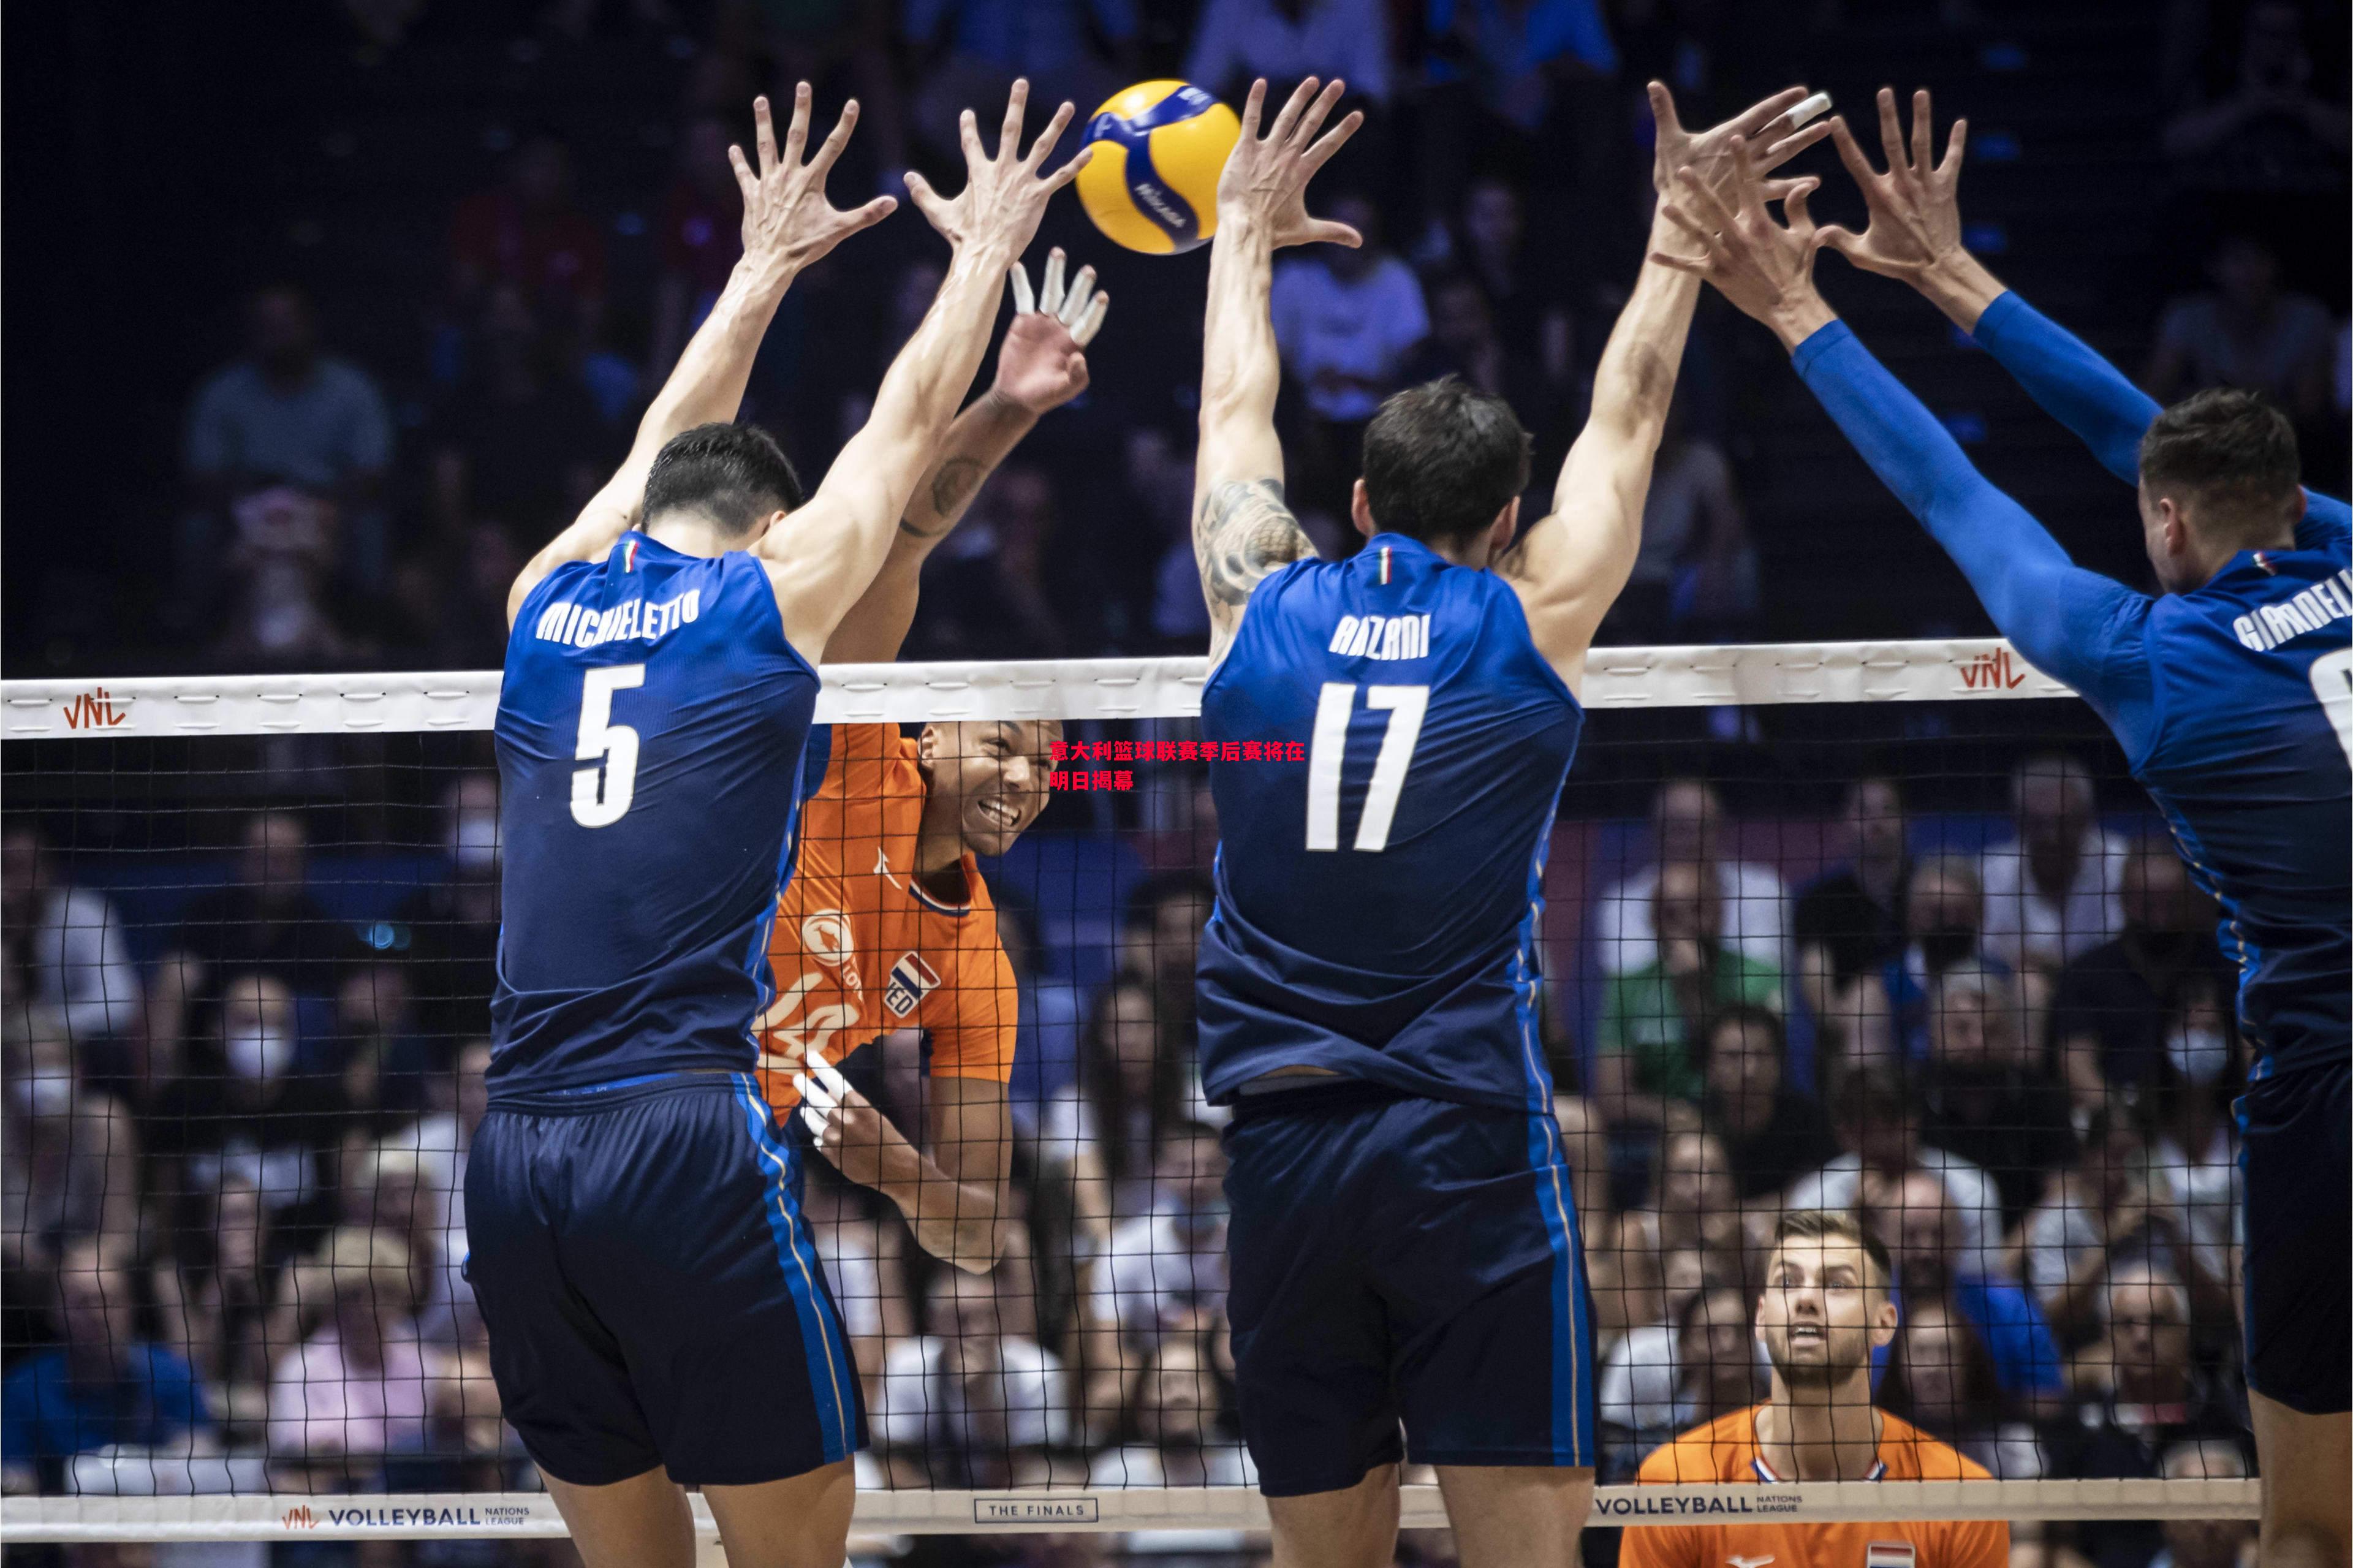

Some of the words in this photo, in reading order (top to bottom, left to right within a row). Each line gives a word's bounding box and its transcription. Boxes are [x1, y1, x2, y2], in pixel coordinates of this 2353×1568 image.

[1960, 647, 2026, 689] VNL
[63, 687, 126, 729] VNL
[570, 664, 645, 828] 5
[1306, 683, 1430, 852] 17
[282, 1505, 319, 1529] VNL
[328, 1507, 480, 1526] VOLLEYBALL
[485, 1507, 529, 1516] NATIONS
[989, 1506, 1018, 1515] THE
[1027, 1505, 1084, 1515] FINALS
[1596, 1497, 1752, 1515] VOLLEYBALL
